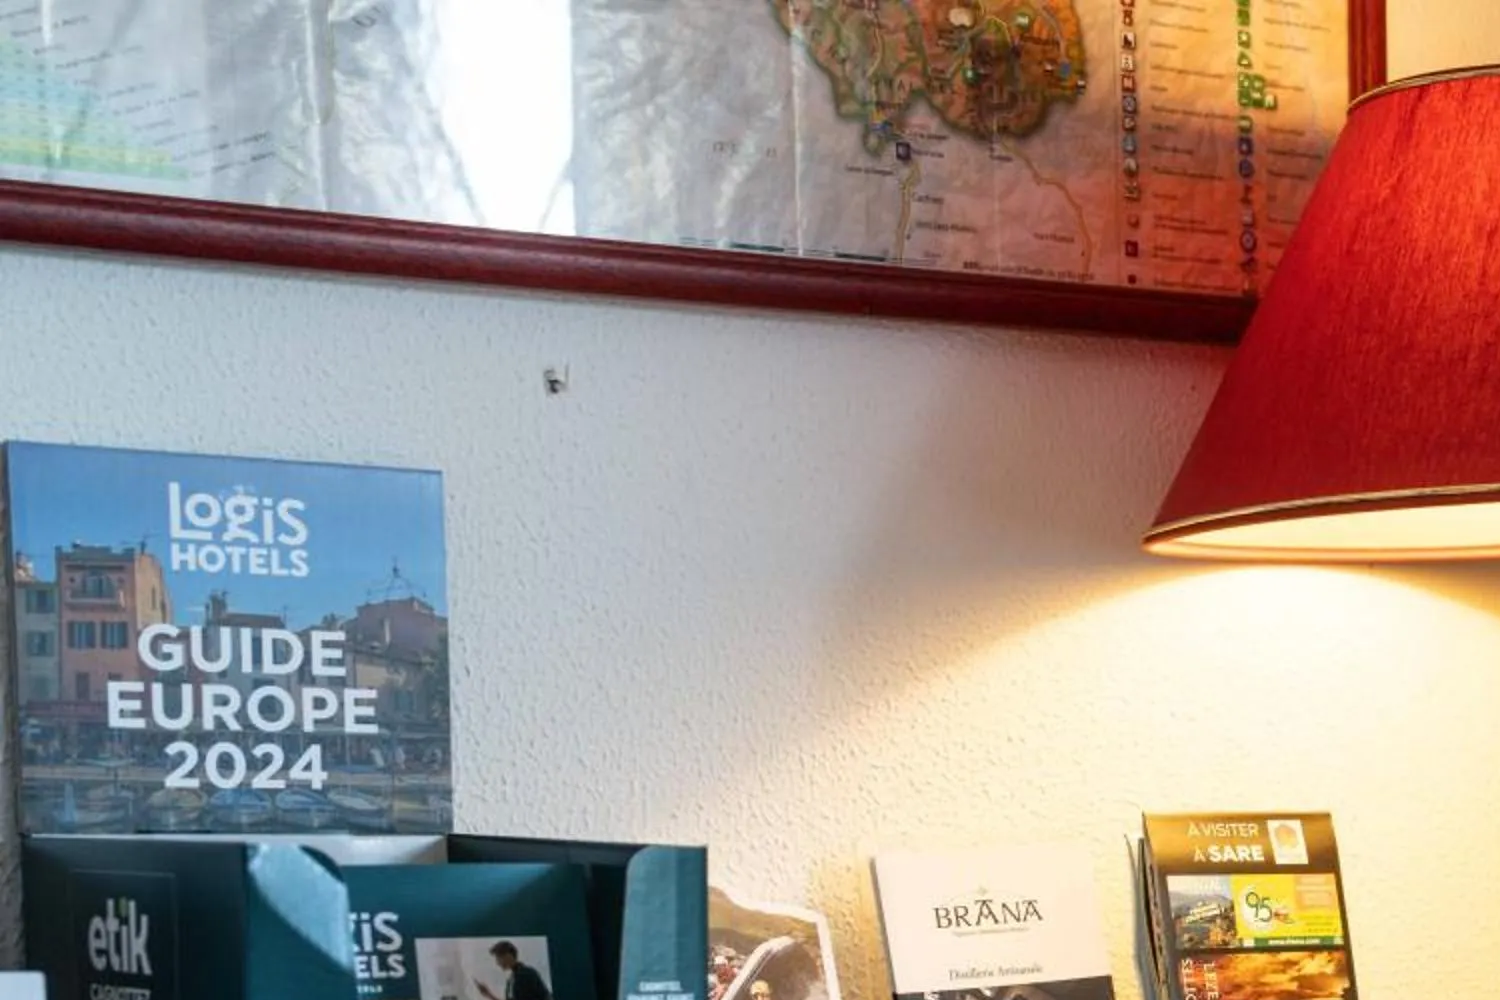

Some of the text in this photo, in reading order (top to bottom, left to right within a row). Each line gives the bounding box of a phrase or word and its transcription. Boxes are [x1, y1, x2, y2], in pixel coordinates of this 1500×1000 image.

[170, 544, 311, 578] HOTELS
[137, 623, 348, 678] GUIDE
[107, 680, 380, 735] EUROPE
[164, 741, 329, 791] 2024
[1207, 844, 1265, 862] SARE
[88, 897, 152, 976] etik
[354, 953, 407, 979] ELS
